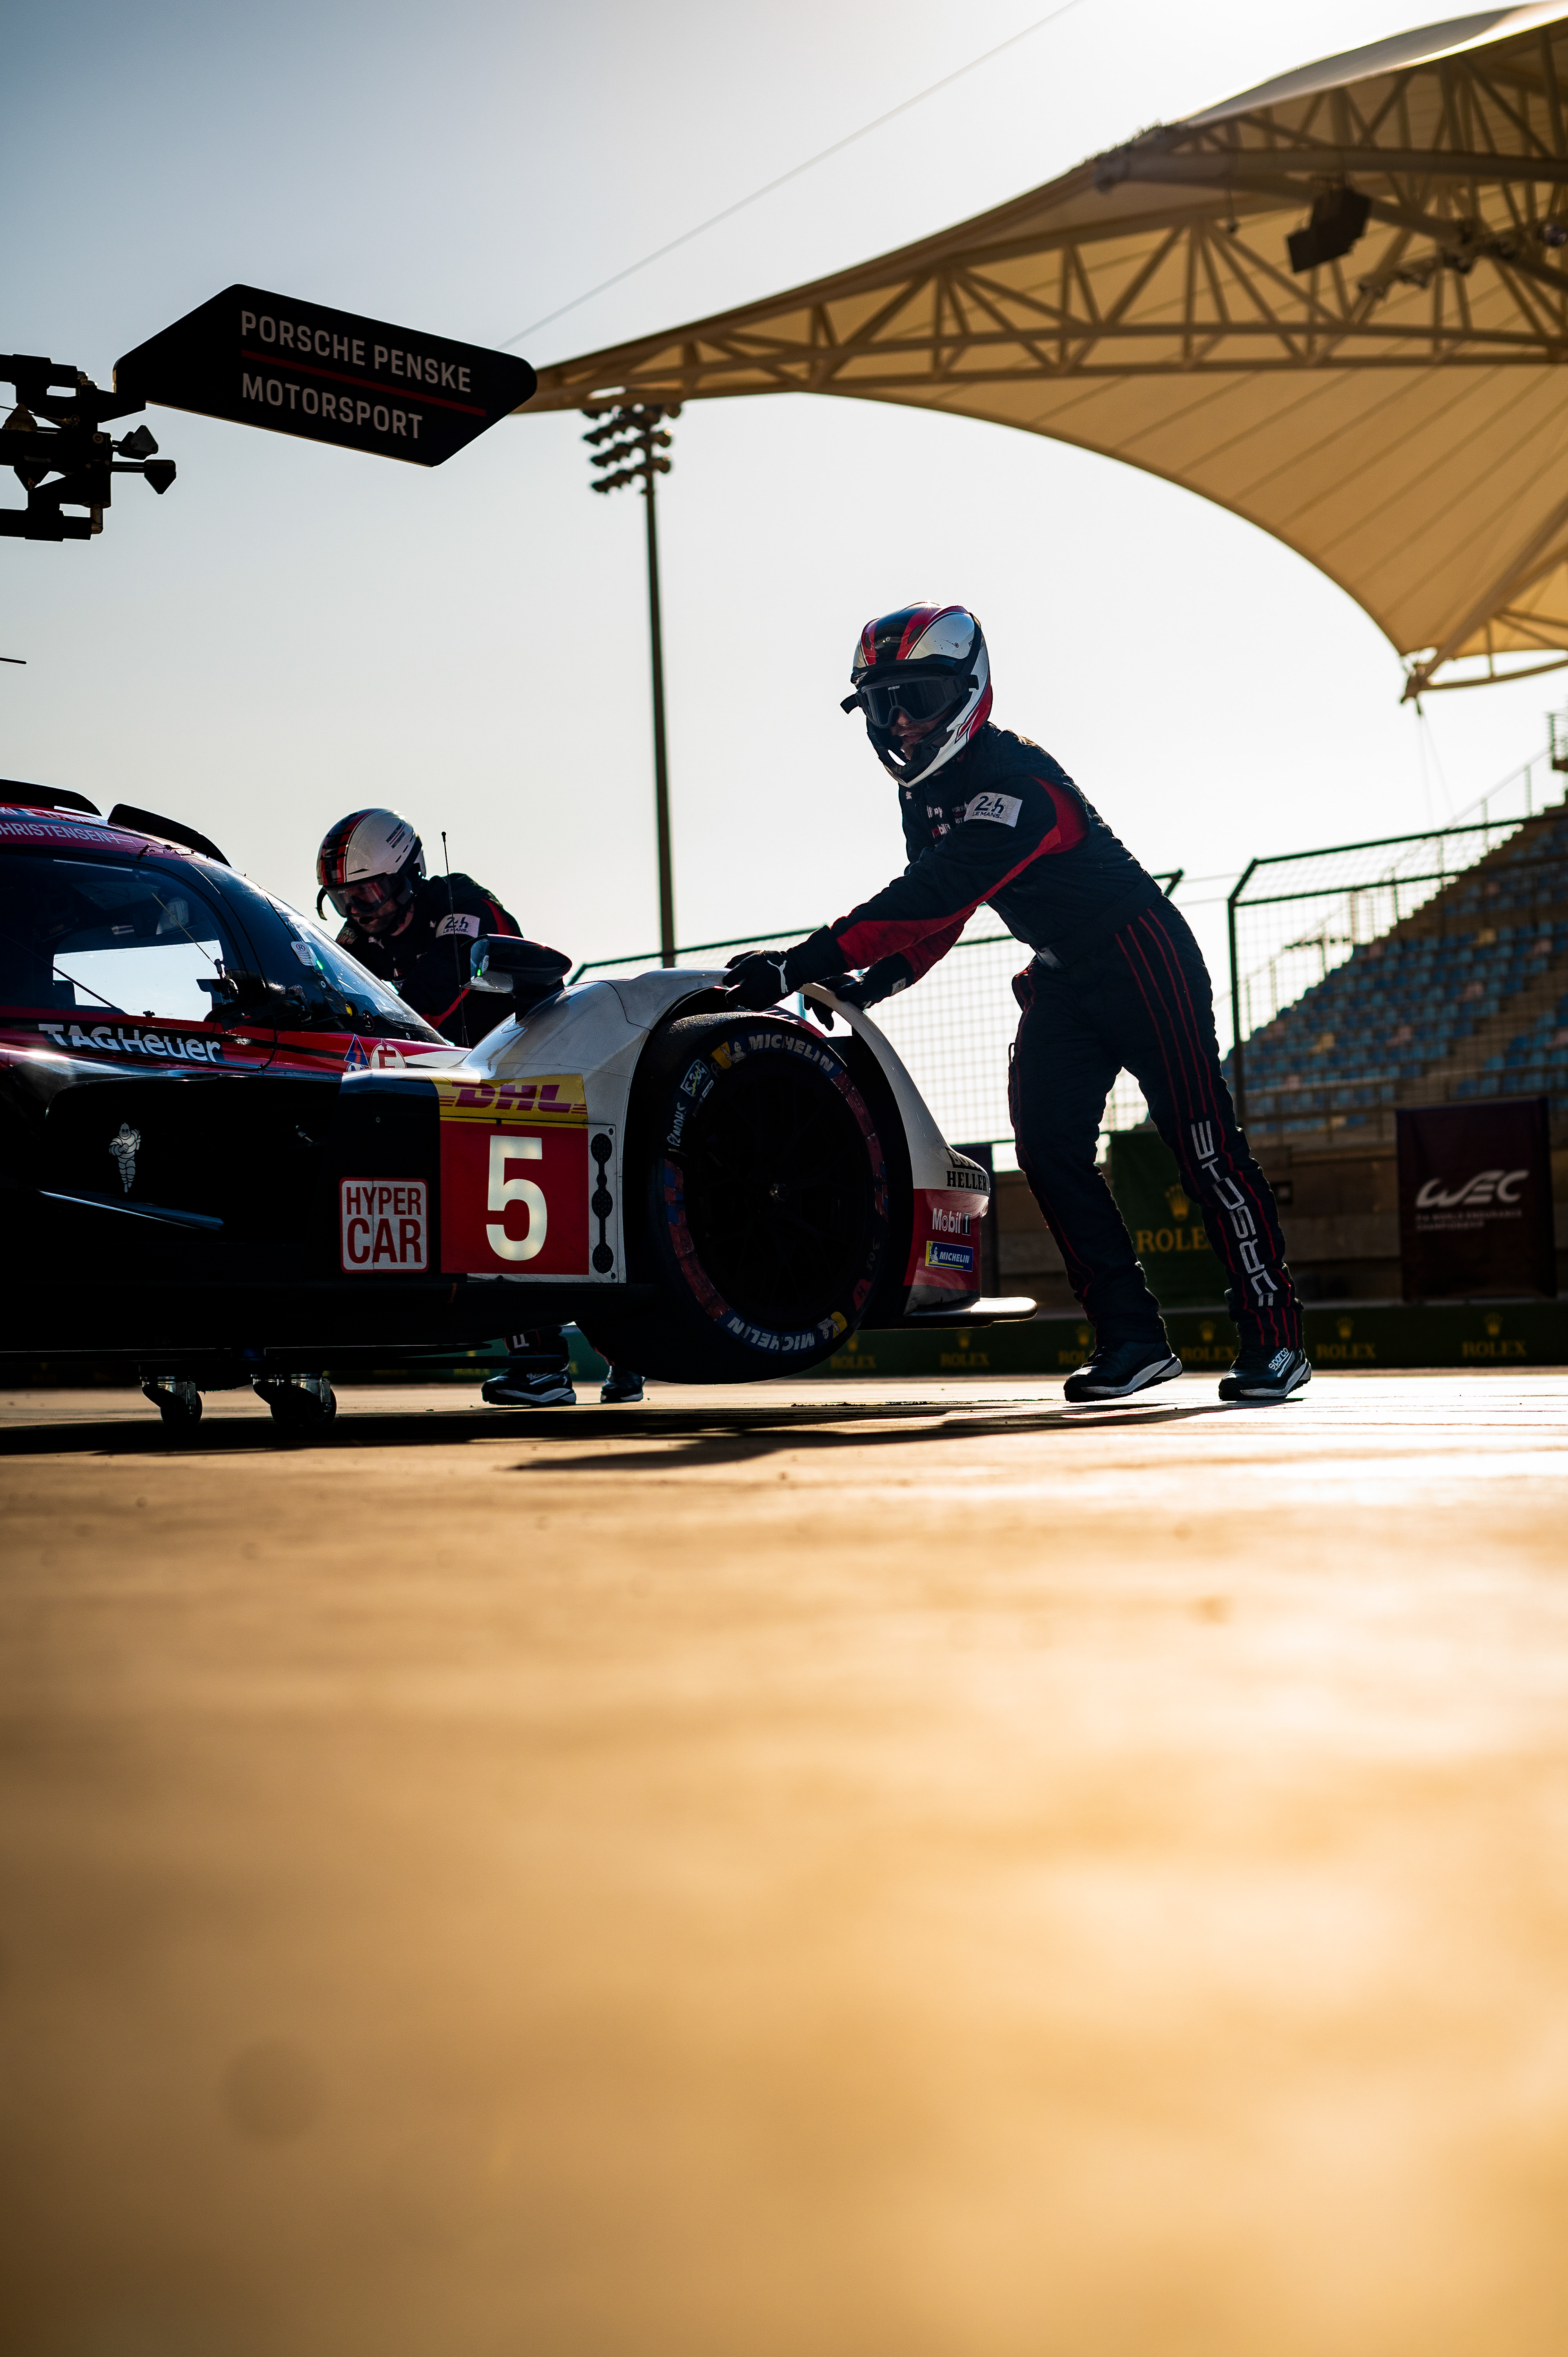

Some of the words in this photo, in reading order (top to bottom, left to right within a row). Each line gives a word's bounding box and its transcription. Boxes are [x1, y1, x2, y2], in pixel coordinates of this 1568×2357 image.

[241, 310, 366, 366] PORSCHE
[374, 344, 472, 392] PENSKE
[241, 373, 423, 439] MOTORSPORT
[0, 823, 112, 843] HRISTENSEN
[748, 1033, 834, 1071] MICHELIN
[452, 1081, 571, 1114] DHL
[947, 1170, 987, 1192] HELLER
[1414, 1168, 1530, 1209] WEC
[346, 1186, 422, 1215] HYPER
[486, 1135, 548, 1261] 5
[932, 1208, 961, 1234] Mobil
[347, 1217, 423, 1264] CAR
[1136, 1229, 1210, 1253] ROLE
[939, 1251, 970, 1264] MICHELIN
[726, 1316, 815, 1351] MICHELIN
[940, 1352, 989, 1367] ROLEX
[1058, 1349, 1089, 1365] ROL
[1267, 1347, 1290, 1371] sparco
[1316, 1343, 1377, 1360] ROLEX
[1462, 1340, 1528, 1358] ROLEX
